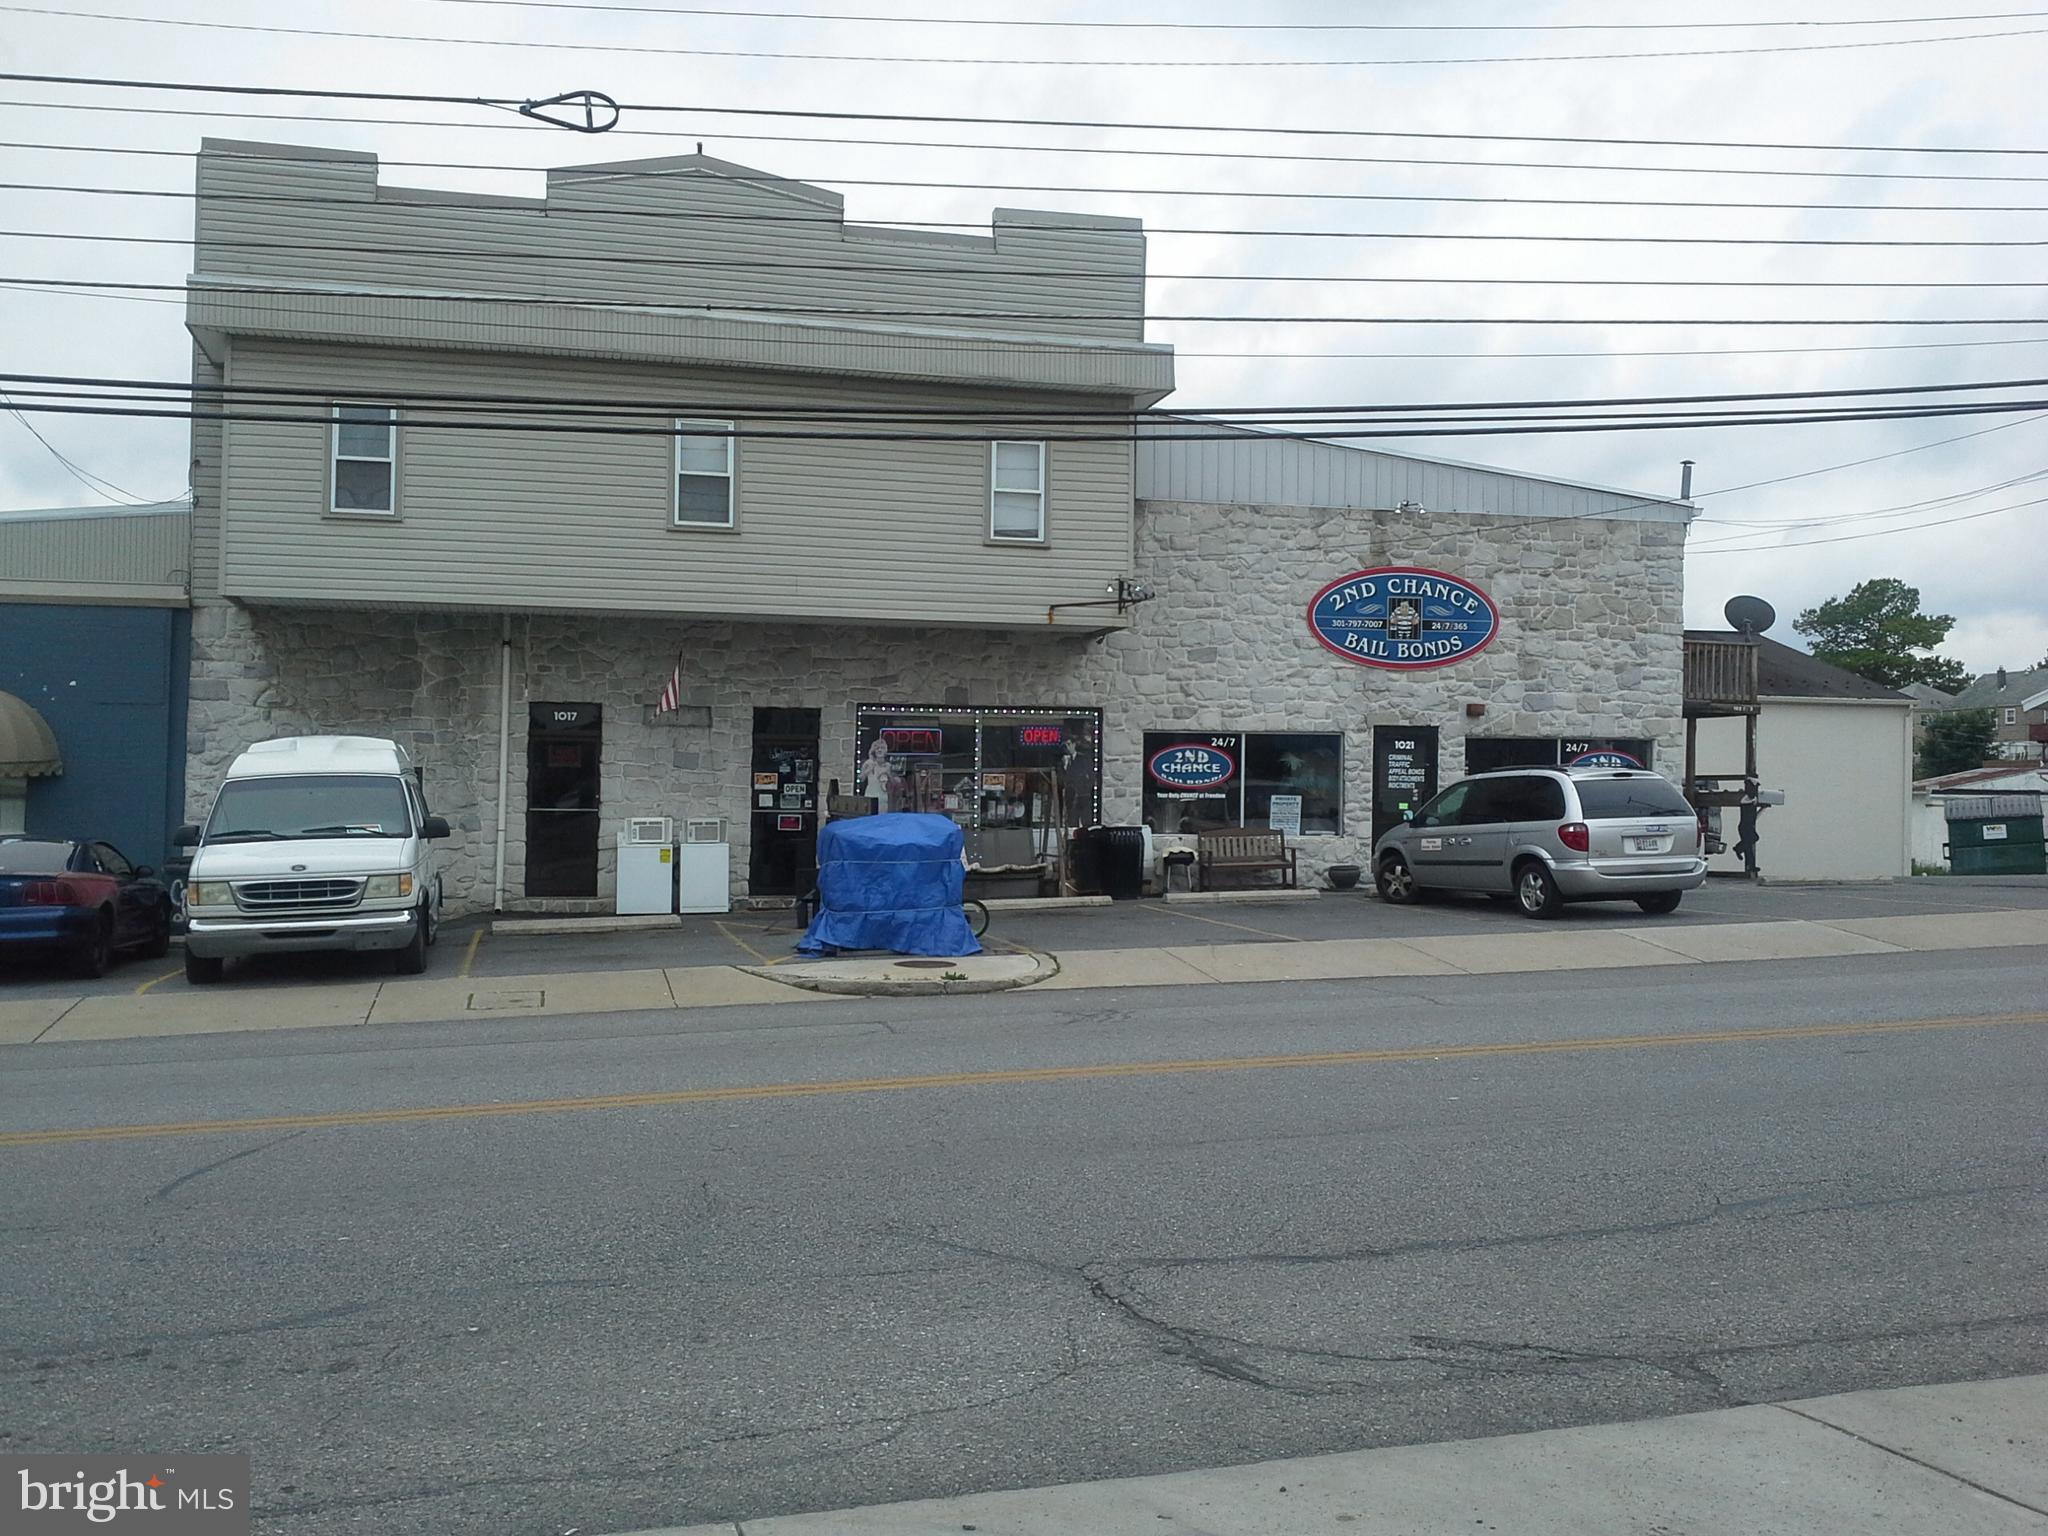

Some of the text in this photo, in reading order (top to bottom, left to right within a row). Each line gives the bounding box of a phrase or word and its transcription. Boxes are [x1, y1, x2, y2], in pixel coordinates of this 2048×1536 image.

[1330, 578, 1479, 615] 2ND CHANCE
[1332, 618, 1384, 629] 301-797-7007
[1344, 632, 1463, 658] BAIL BONDS
[553, 711, 578, 721] 1017
[883, 731, 941, 752] OPEN
[1024, 730, 1059, 743] OPEN
[1211, 737, 1236, 748] 24/7
[1394, 740, 1415, 750] 1021
[1565, 743, 1589, 753] 24/7
[1175, 750, 1209, 763] 2ND
[1161, 763, 1221, 773] CHANCE
[785, 785, 805, 793] OPEN
